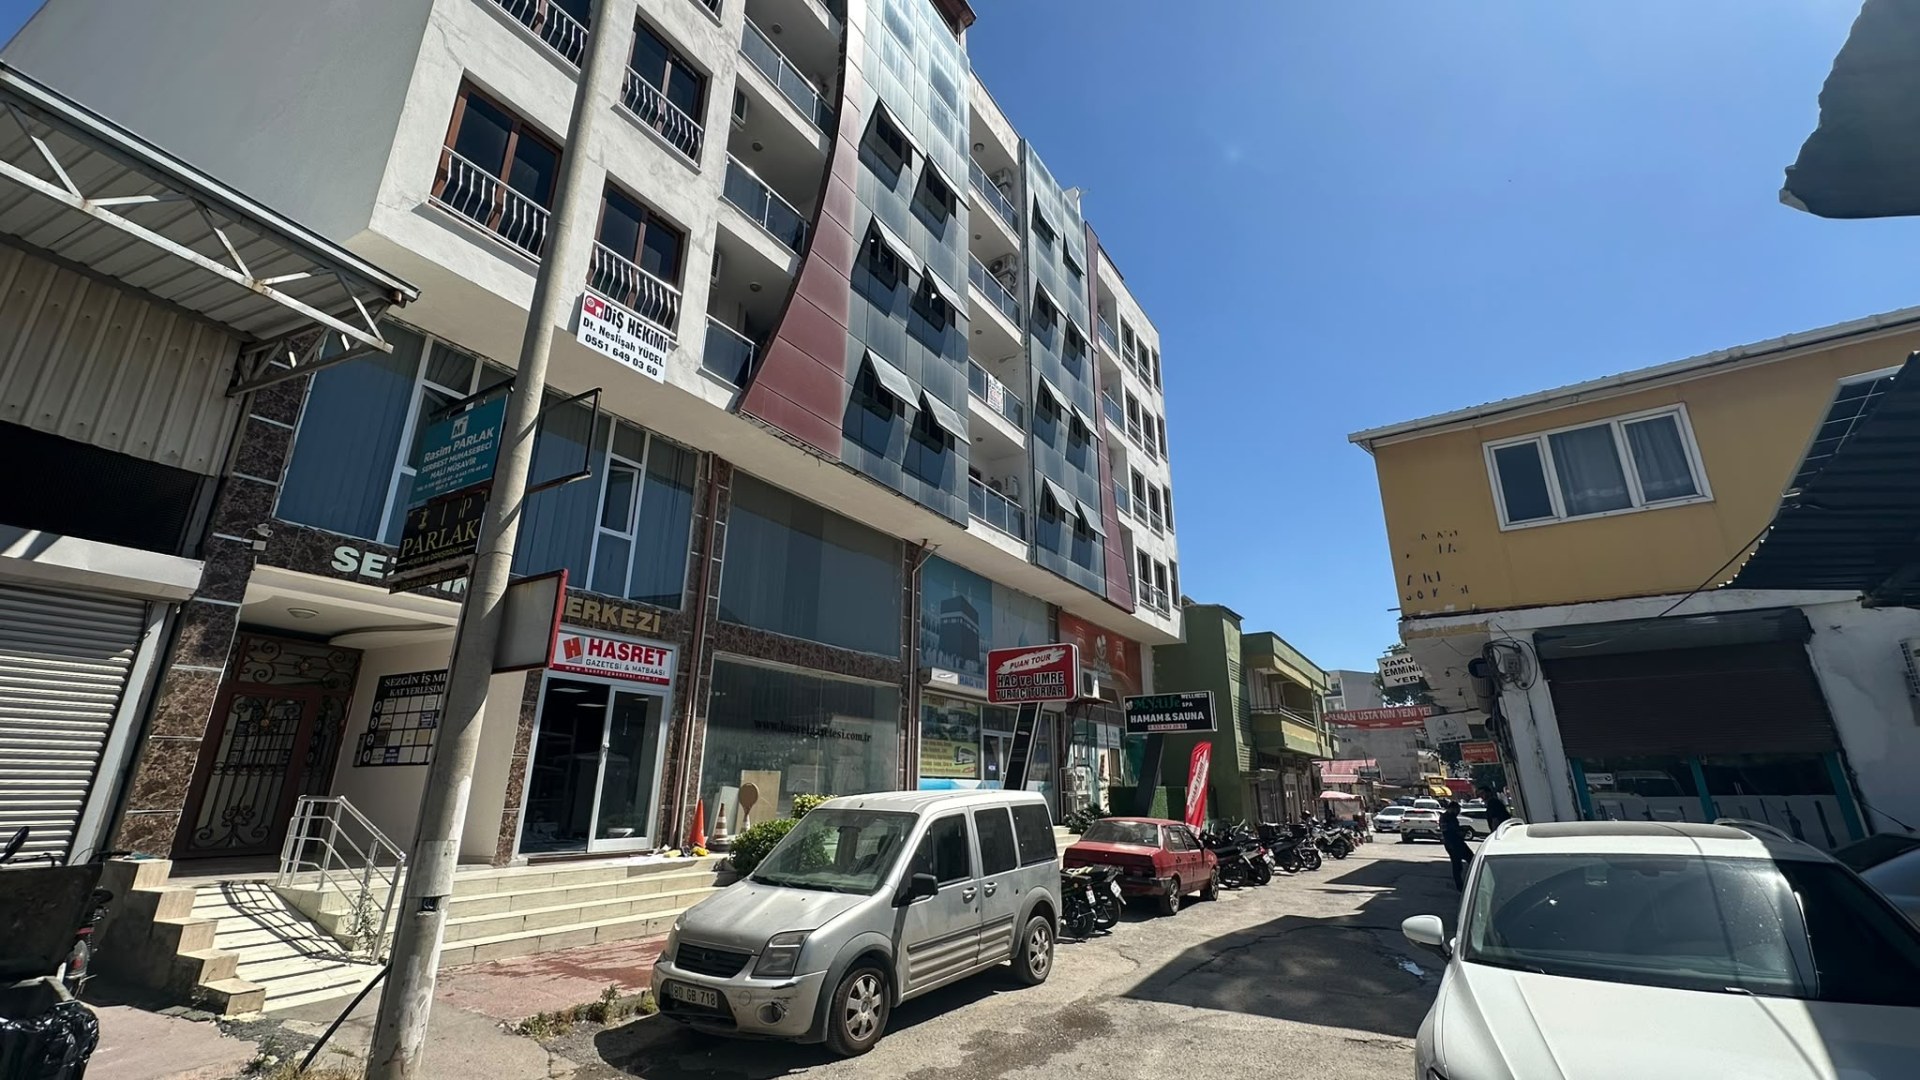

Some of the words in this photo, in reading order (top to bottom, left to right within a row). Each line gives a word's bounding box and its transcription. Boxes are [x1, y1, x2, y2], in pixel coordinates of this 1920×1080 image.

[583, 317, 595, 331] Dt.
[599, 325, 635, 352] Neslişah
[638, 346, 664, 367] YÜCEL
[585, 334, 608, 352] 0551
[612, 347, 630, 362] 649
[632, 358, 644, 369] 03
[646, 365, 658, 376] 60
[424, 446, 451, 463] Rasim
[453, 427, 494, 451] PARLAK
[421, 458, 449, 473] SERBEST
[400, 518, 479, 558] PARLAK
[588, 638, 667, 666] HASRET
[1009, 659, 1030, 669] PUAN
[1031, 654, 1052, 665] TOUR
[996, 673, 1018, 687] HAC
[1019, 675, 1032, 686] ve
[1033, 671, 1064, 685] UMRE
[389, 688, 404, 697] KAT
[1130, 713, 1164, 723] HAMAM
[1172, 711, 1205, 721] SAUNA
